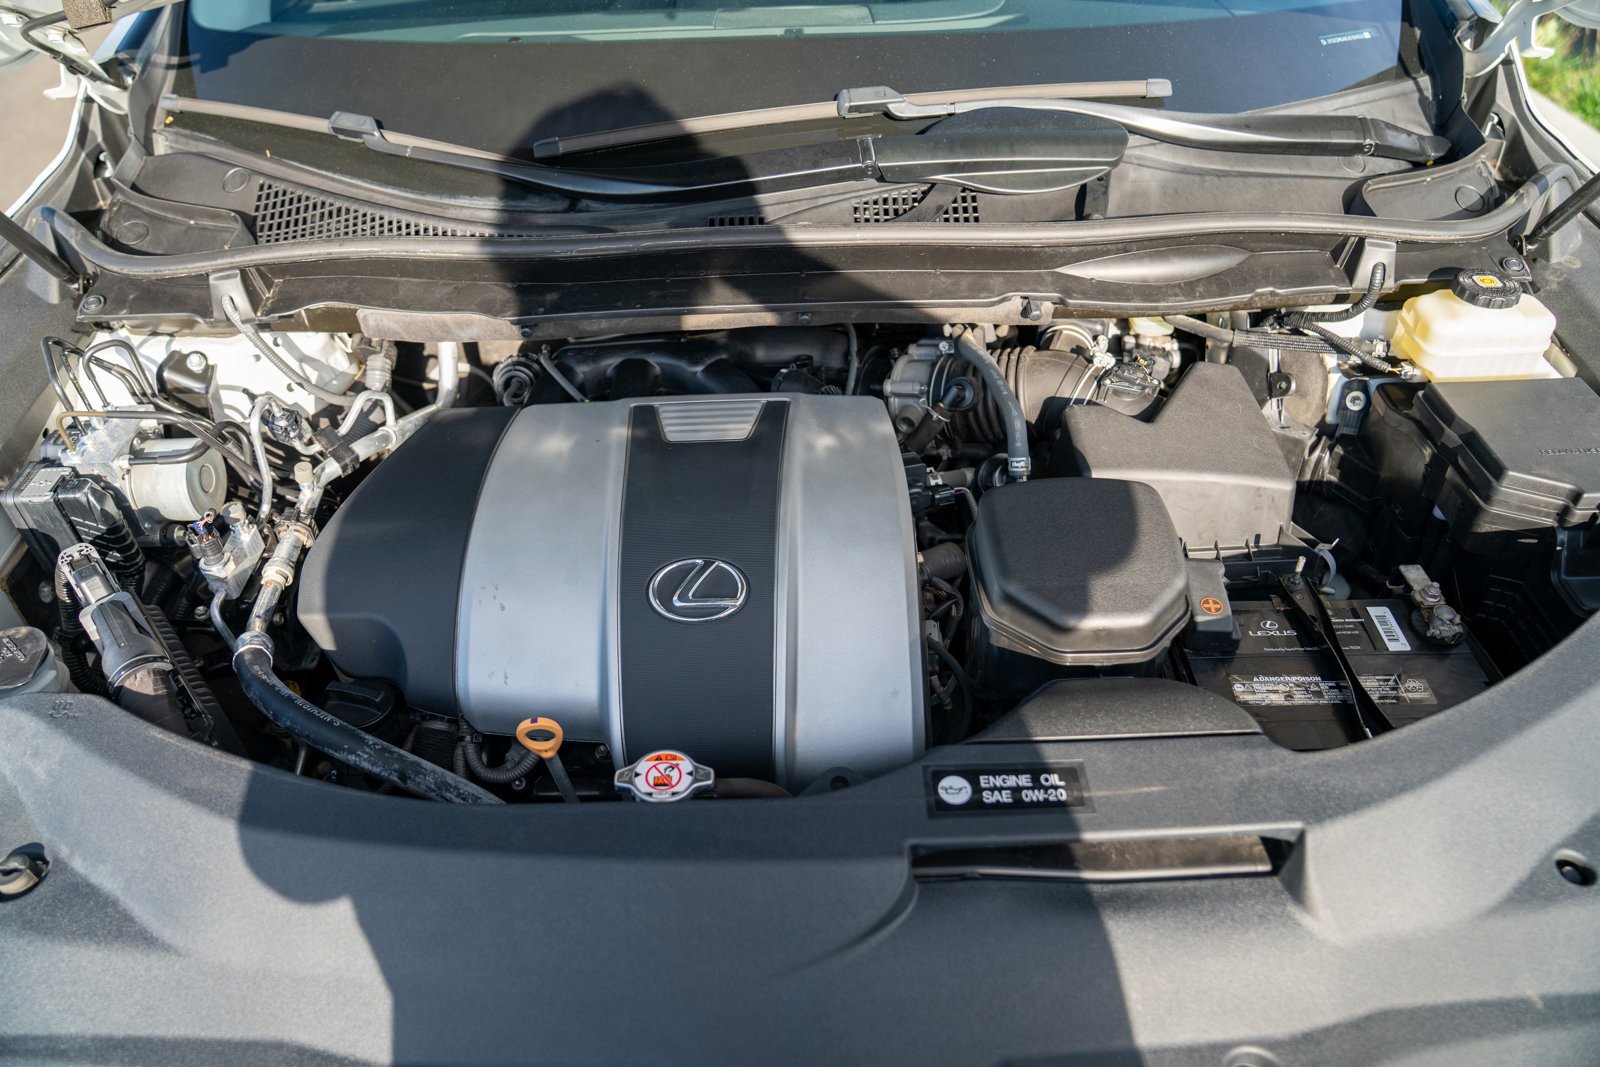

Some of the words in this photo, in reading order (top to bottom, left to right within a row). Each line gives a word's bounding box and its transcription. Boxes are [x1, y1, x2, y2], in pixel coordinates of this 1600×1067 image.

[979, 774, 1032, 788] ENGINE
[1040, 773, 1066, 786] OIL
[982, 789, 1014, 804] SAE
[1021, 788, 1068, 803] 0W-20
